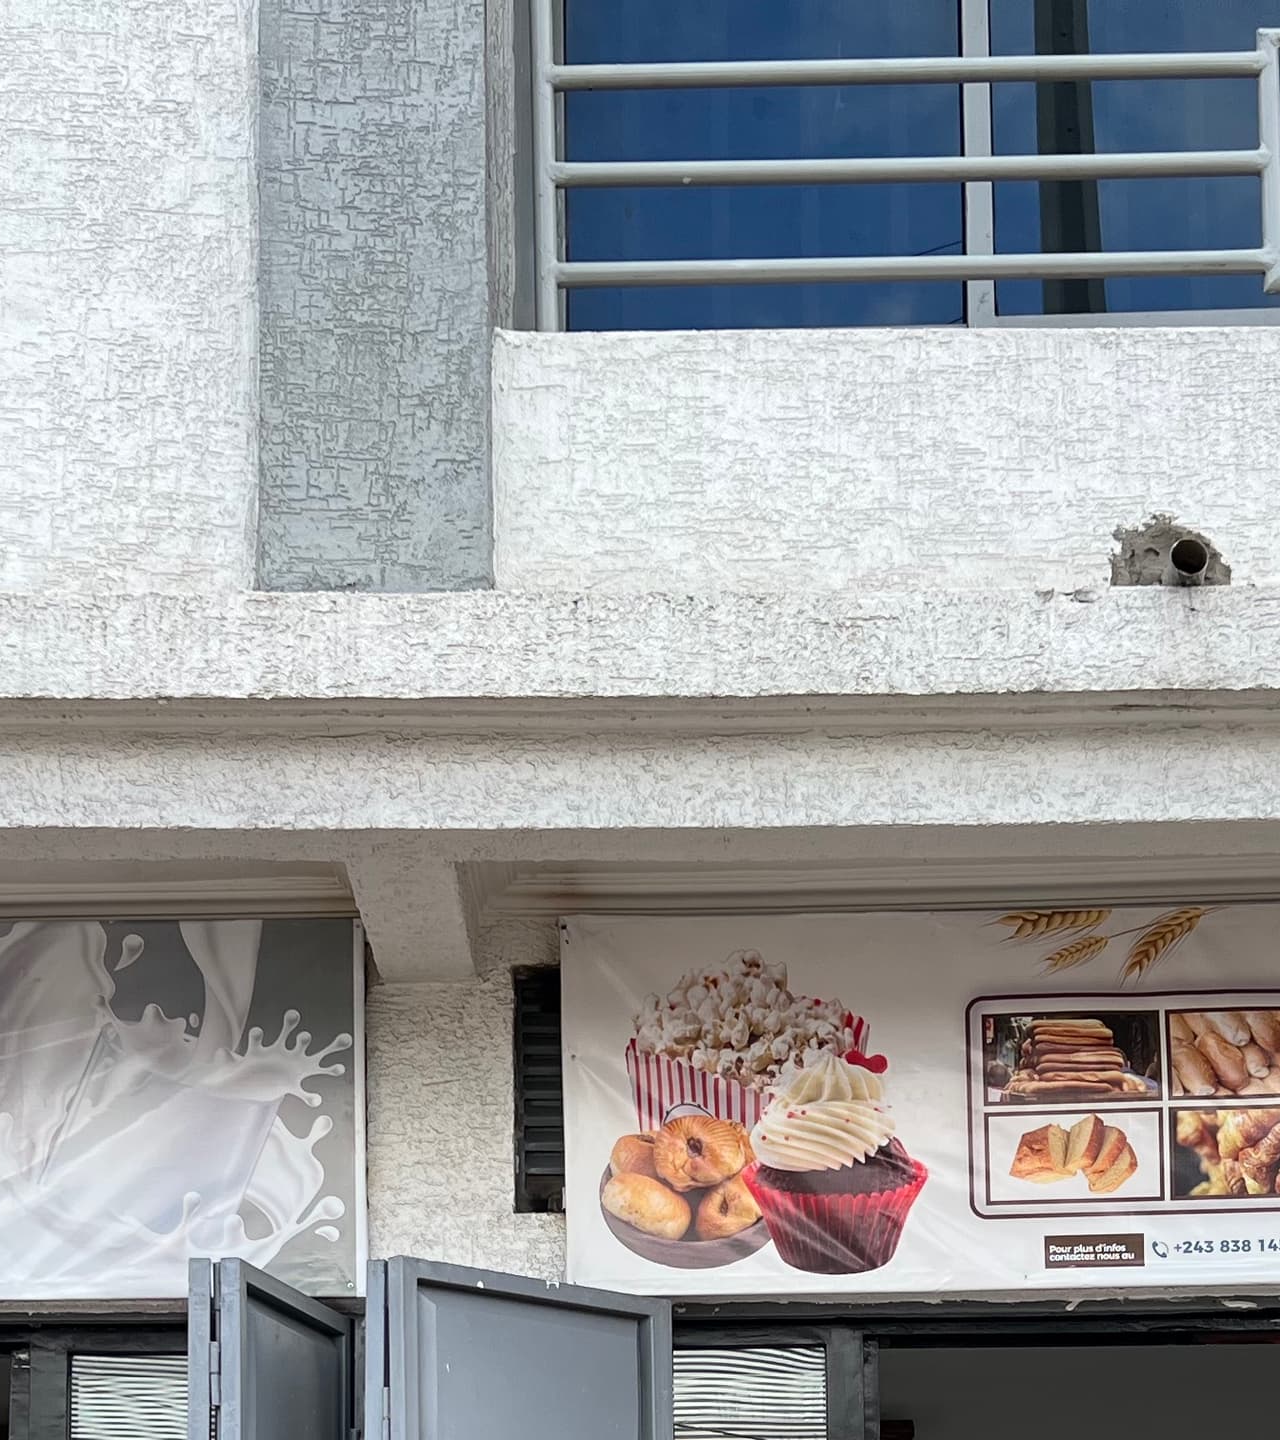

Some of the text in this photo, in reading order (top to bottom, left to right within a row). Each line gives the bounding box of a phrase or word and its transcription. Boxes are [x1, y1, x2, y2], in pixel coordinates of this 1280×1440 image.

[1048, 1243, 1127, 1254] Pour plus d'infos
[1173, 1240, 1215, 1254] +243
[1220, 1239, 1252, 1253] 838
[1049, 1252, 1135, 1262] contactez nous au
